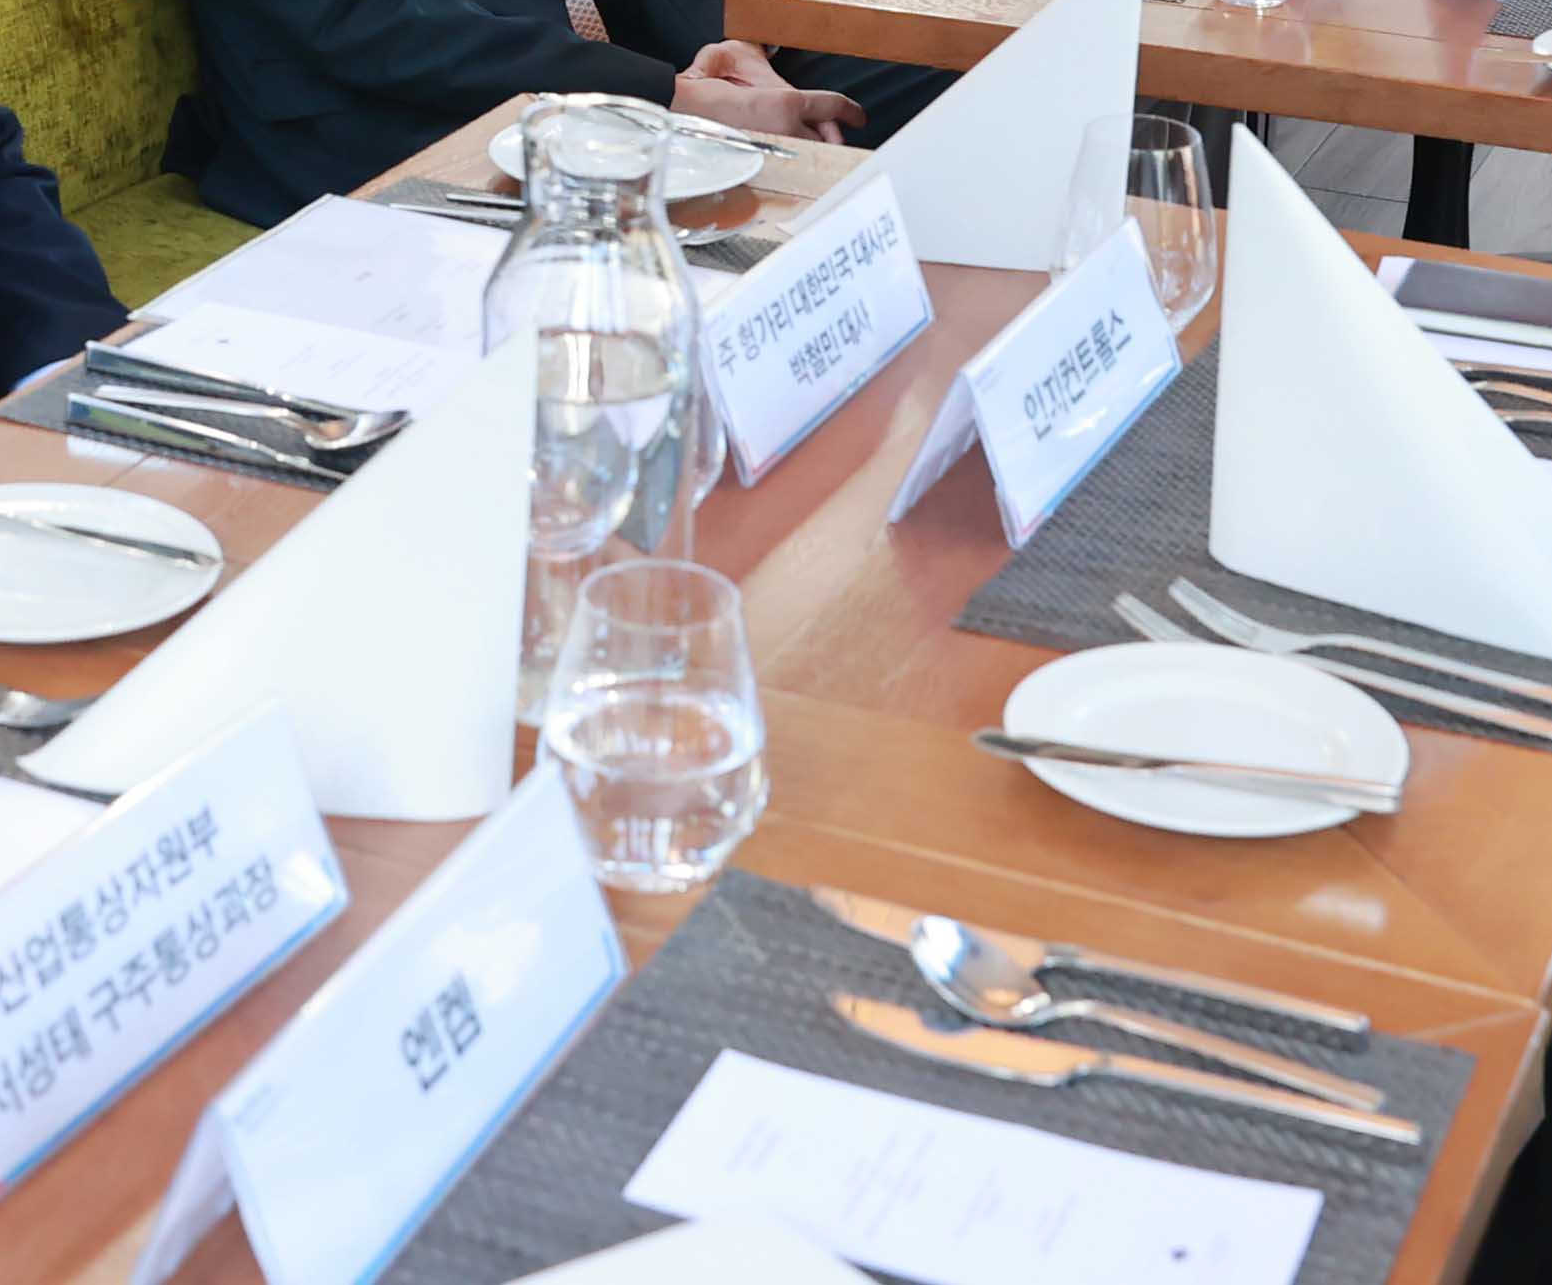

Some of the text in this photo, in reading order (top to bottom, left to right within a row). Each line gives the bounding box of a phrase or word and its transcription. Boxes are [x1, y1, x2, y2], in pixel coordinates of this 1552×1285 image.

[718, 212, 899, 376] 주 헝가리 대한민국 대사관
[788, 297, 873, 387] 박철민 대사
[1022, 309, 1133, 441] 인지컨트롤스
[87, 851, 280, 1034] 구주통상과장
[396, 972, 487, 1094] 엔켐
